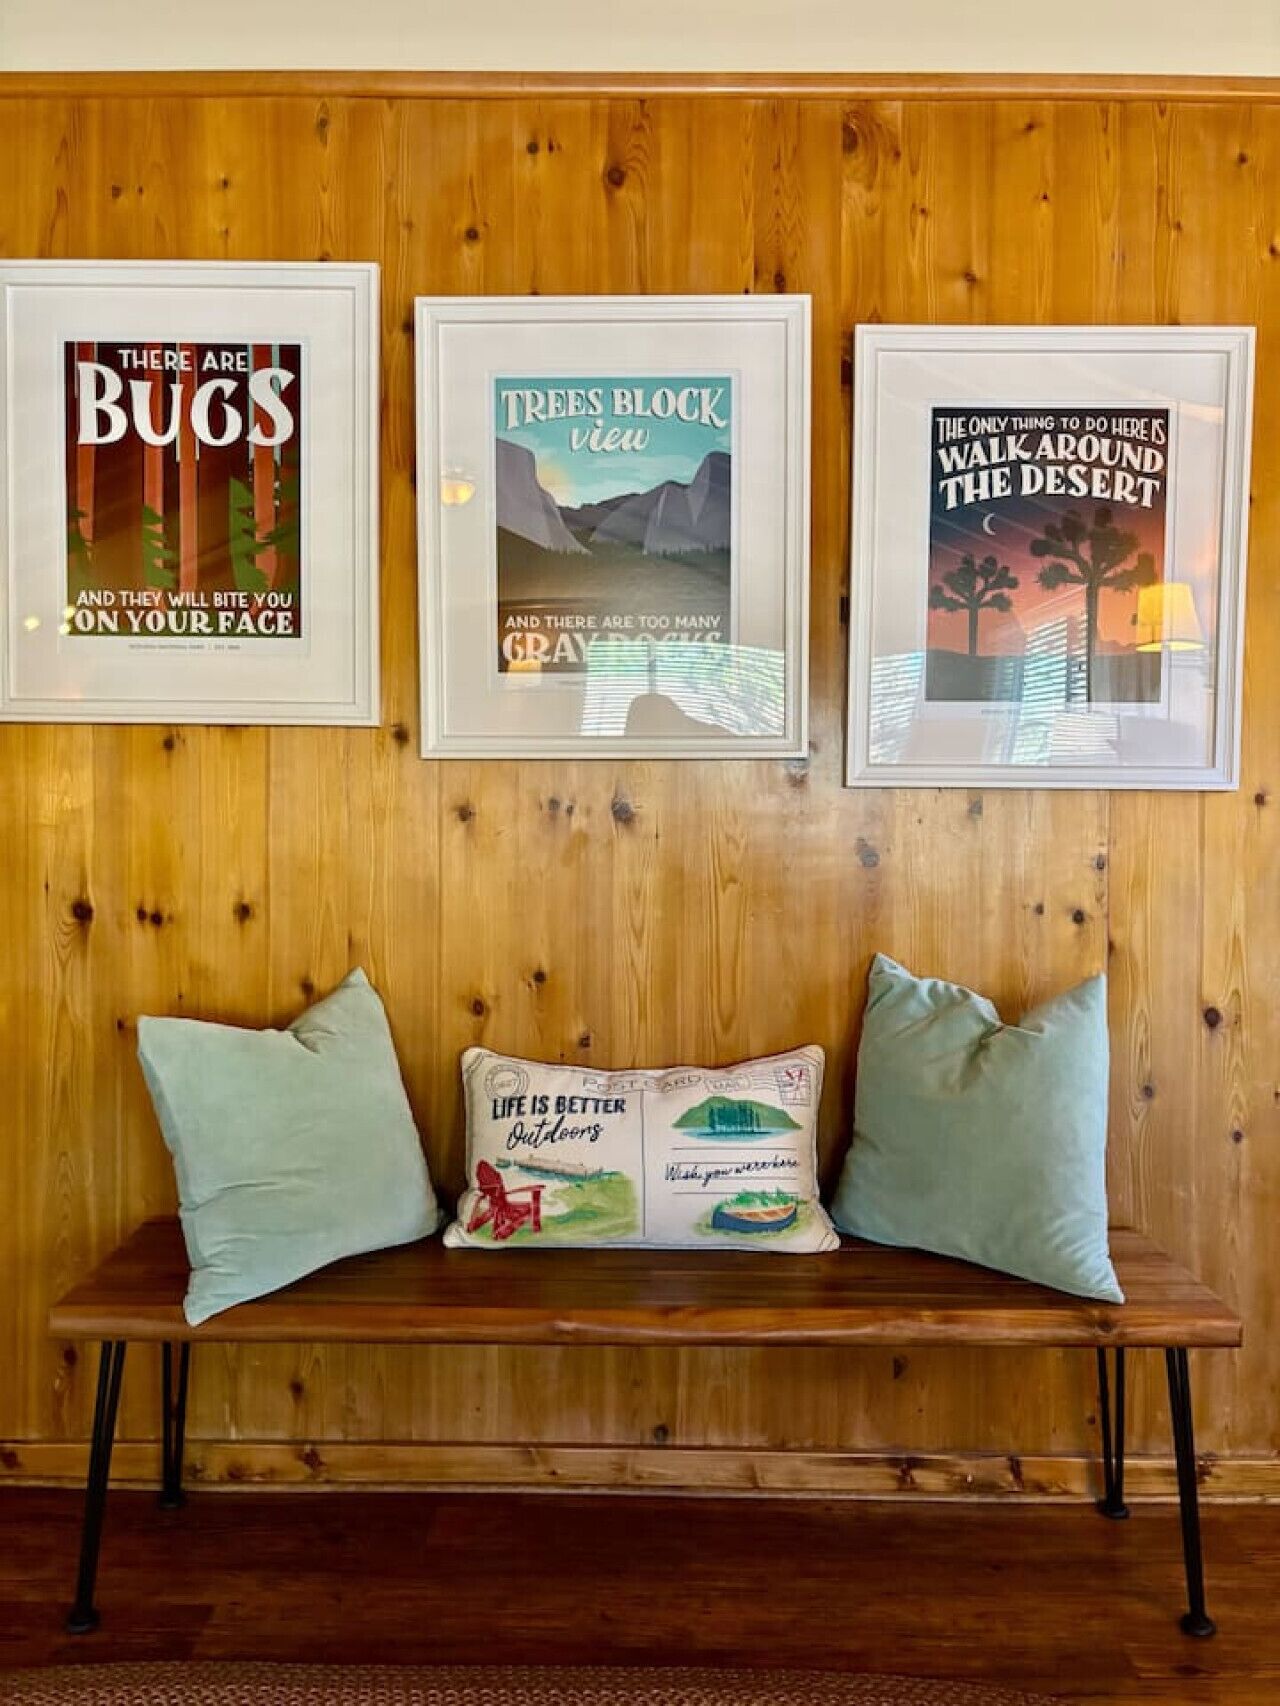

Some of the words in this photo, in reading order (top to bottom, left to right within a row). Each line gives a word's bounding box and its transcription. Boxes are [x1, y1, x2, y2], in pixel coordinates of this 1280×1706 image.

[118, 350, 192, 372] THERE
[202, 351, 248, 372] ARE
[77, 362, 296, 447] BUGS
[501, 387, 603, 430] TREES
[613, 386, 728, 428] BLOCK
[570, 418, 650, 453] view
[936, 416, 967, 443] THE
[969, 415, 1009, 433] ONLY
[1010, 416, 1054, 431] THING
[1061, 416, 1080, 430] TO
[1086, 416, 1107, 432] DO
[1112, 417, 1149, 441] HERE
[1151, 418, 1166, 445] IS
[938, 433, 1033, 474] WALK
[1036, 433, 1164, 475] AROUND
[939, 465, 1012, 510] THE
[1020, 465, 1160, 509] DESERT
[76, 591, 114, 608] AND
[118, 591, 163, 608] THEY
[168, 591, 209, 608] WILL
[214, 591, 248, 608] BITE
[254, 592, 293, 608] YOU
[74, 609, 119, 633] ON
[125, 610, 213, 634] YOUR
[218, 611, 294, 635] FACE
[505, 615, 541, 629] AND
[545, 615, 596, 629] THERE
[602, 615, 634, 629] ARE
[639, 615, 670, 629] TOO
[675, 615, 721, 629] MANY
[492, 1095, 526, 1120] LIFE
[530, 1095, 550, 1116] IS
[554, 1096, 626, 1115] BETTER
[506, 1116, 603, 1151] Outdoors
[665, 1163, 703, 1181] Wish
